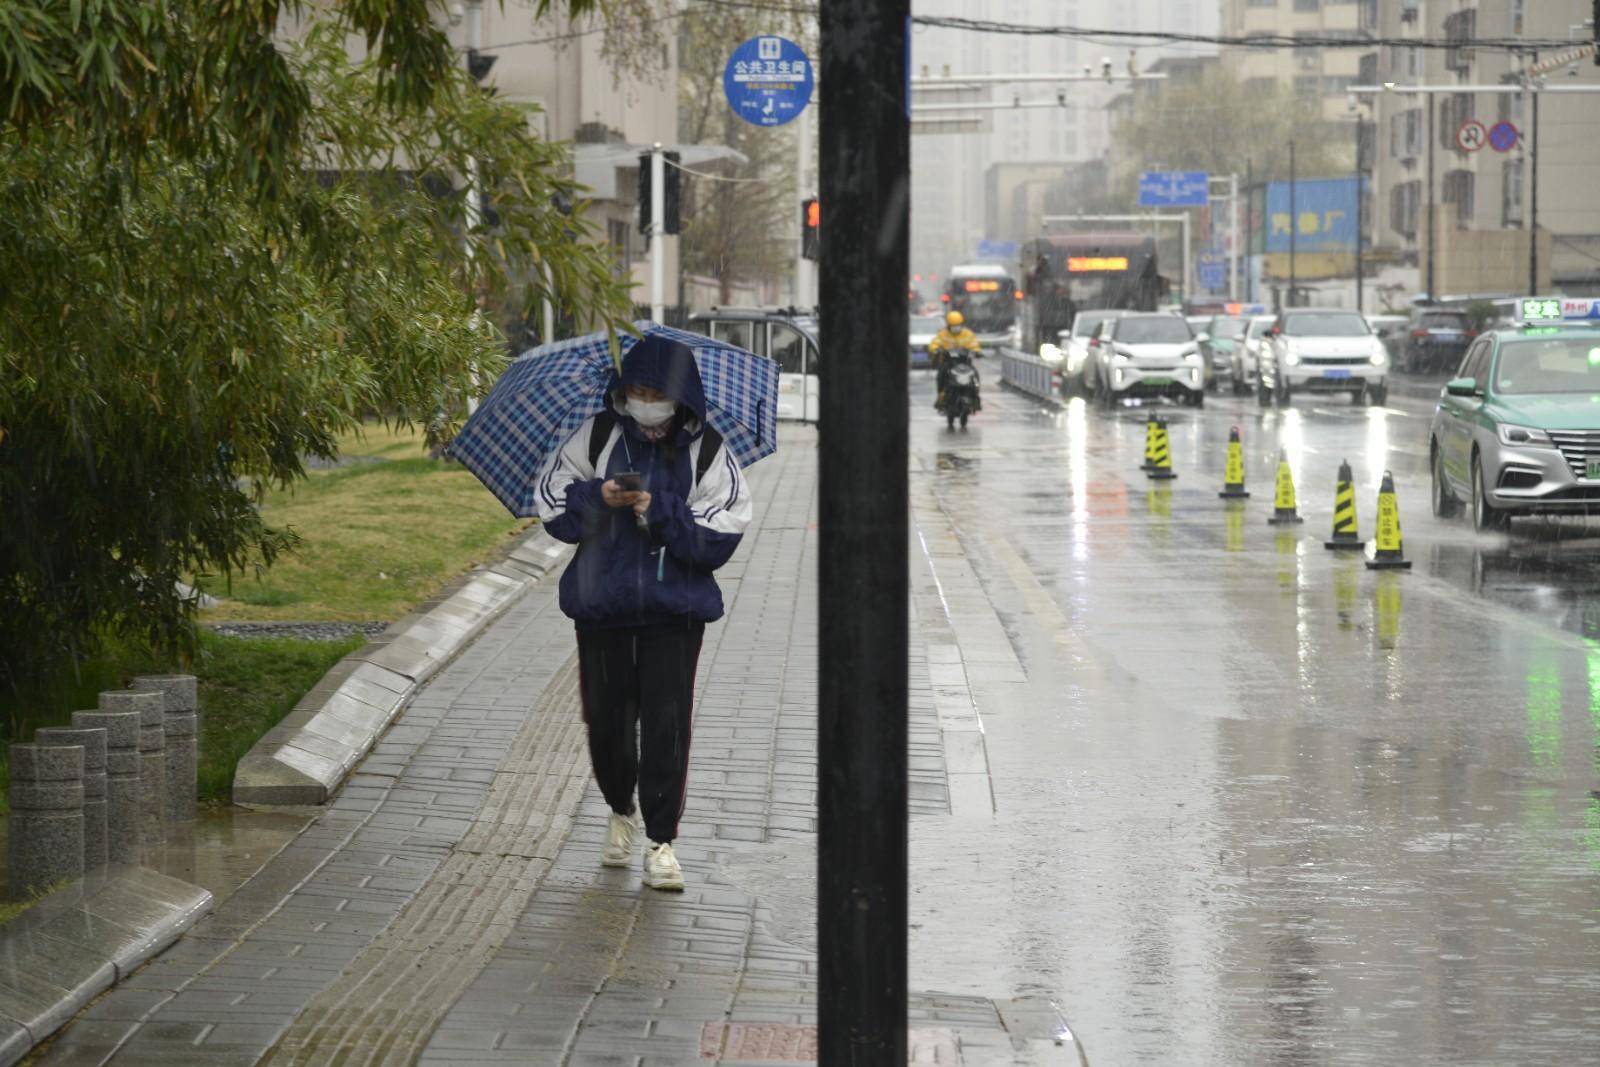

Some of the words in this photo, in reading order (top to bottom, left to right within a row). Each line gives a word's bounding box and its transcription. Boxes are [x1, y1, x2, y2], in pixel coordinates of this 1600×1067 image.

[735, 61, 805, 74] 公共卫生间
